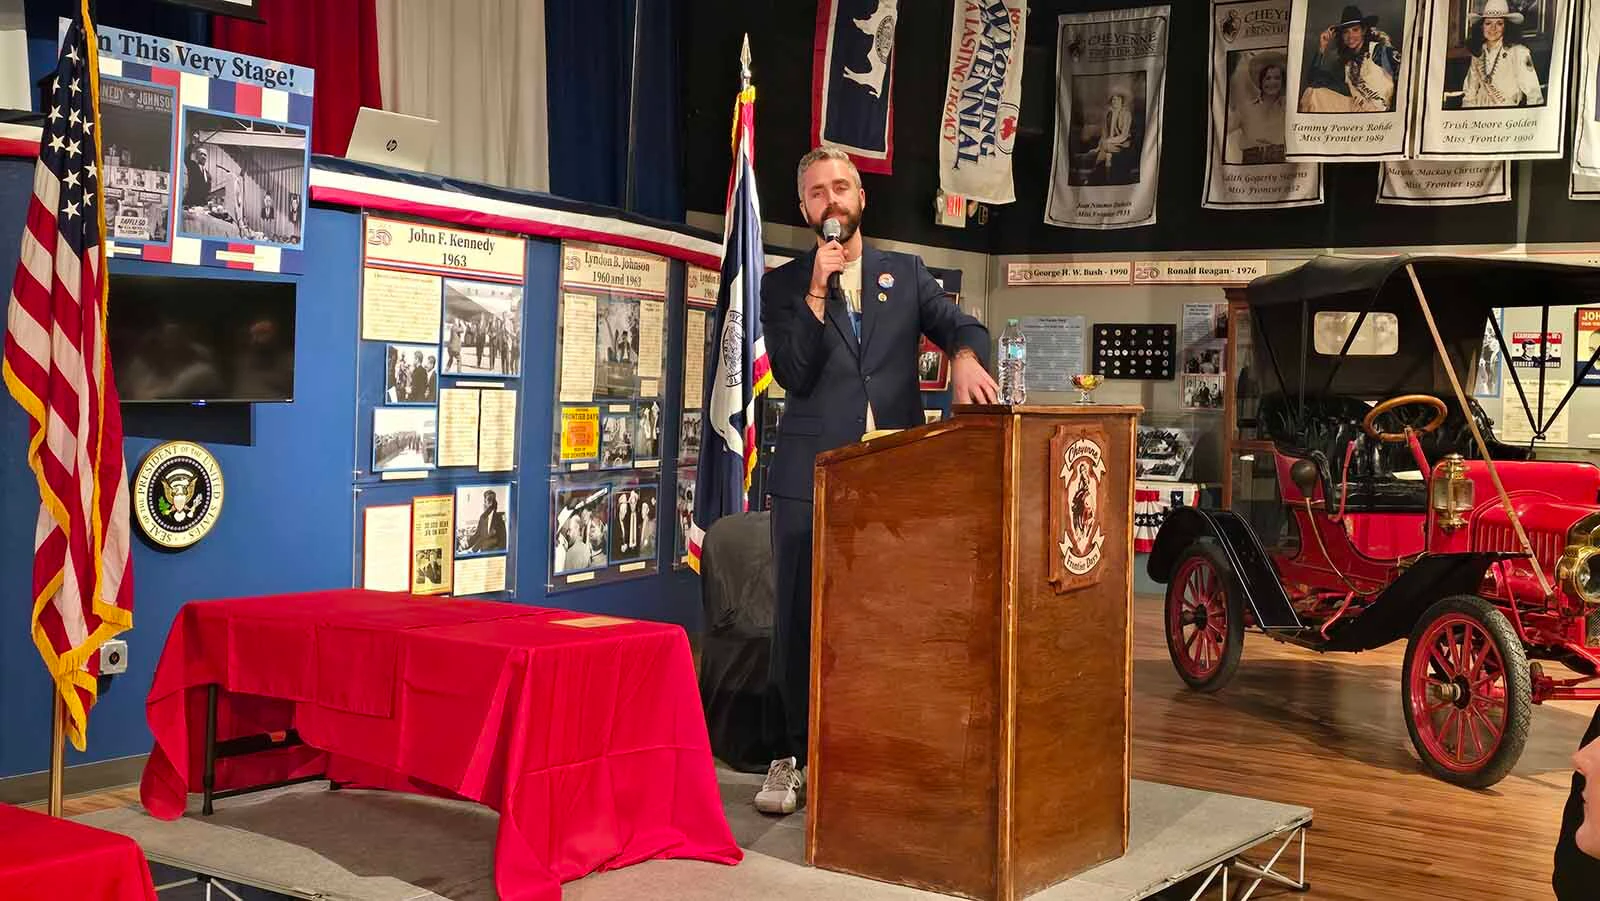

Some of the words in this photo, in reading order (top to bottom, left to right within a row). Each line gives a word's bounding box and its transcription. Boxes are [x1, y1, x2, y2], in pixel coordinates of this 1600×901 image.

[951, 18, 980, 83] LASTING
[118, 34, 171, 64] This
[175, 45, 226, 79] Very
[231, 56, 295, 88] Stage!
[944, 86, 960, 144] LEGACY
[1291, 123, 1328, 134] Tammy
[1330, 123, 1365, 132] Powers
[1366, 121, 1393, 132] Rohde
[1442, 120, 1469, 130] Trish
[1471, 121, 1504, 129] Moore
[1505, 119, 1538, 130] Golden
[1299, 134, 1322, 143] Miss
[1324, 134, 1364, 145] Frontier
[1365, 134, 1385, 143] 1989
[1442, 134, 1466, 144] Miss
[1468, 134, 1511, 145] Frontier
[1513, 134, 1535, 143] 1990
[1424, 180, 1462, 190] Frontier
[408, 227, 436, 244] John
[438, 231, 448, 246] F.
[450, 233, 496, 255] Kennedy
[442, 252, 467, 267] 1963
[585, 251, 614, 268] Lyndon
[613, 256, 622, 268] B.
[621, 256, 650, 272] Johnson
[592, 271, 610, 284] 1960
[611, 274, 625, 285] and
[626, 275, 642, 287] 1963
[1033, 268, 1060, 279] George
[1061, 268, 1071, 277] H.
[1072, 268, 1082, 277] W.
[1083, 268, 1104, 276] Bush
[1109, 268, 1129, 276] 1990
[1167, 266, 1197, 275] Ronald
[1198, 267, 1230, 276] Reagan
[1236, 266, 1257, 275] 1976
[138, 445, 177, 495] PRESIDENT
[202, 456, 221, 500] UNITED
[188, 505, 217, 538] STATES
[150, 523, 173, 542] SEAL
